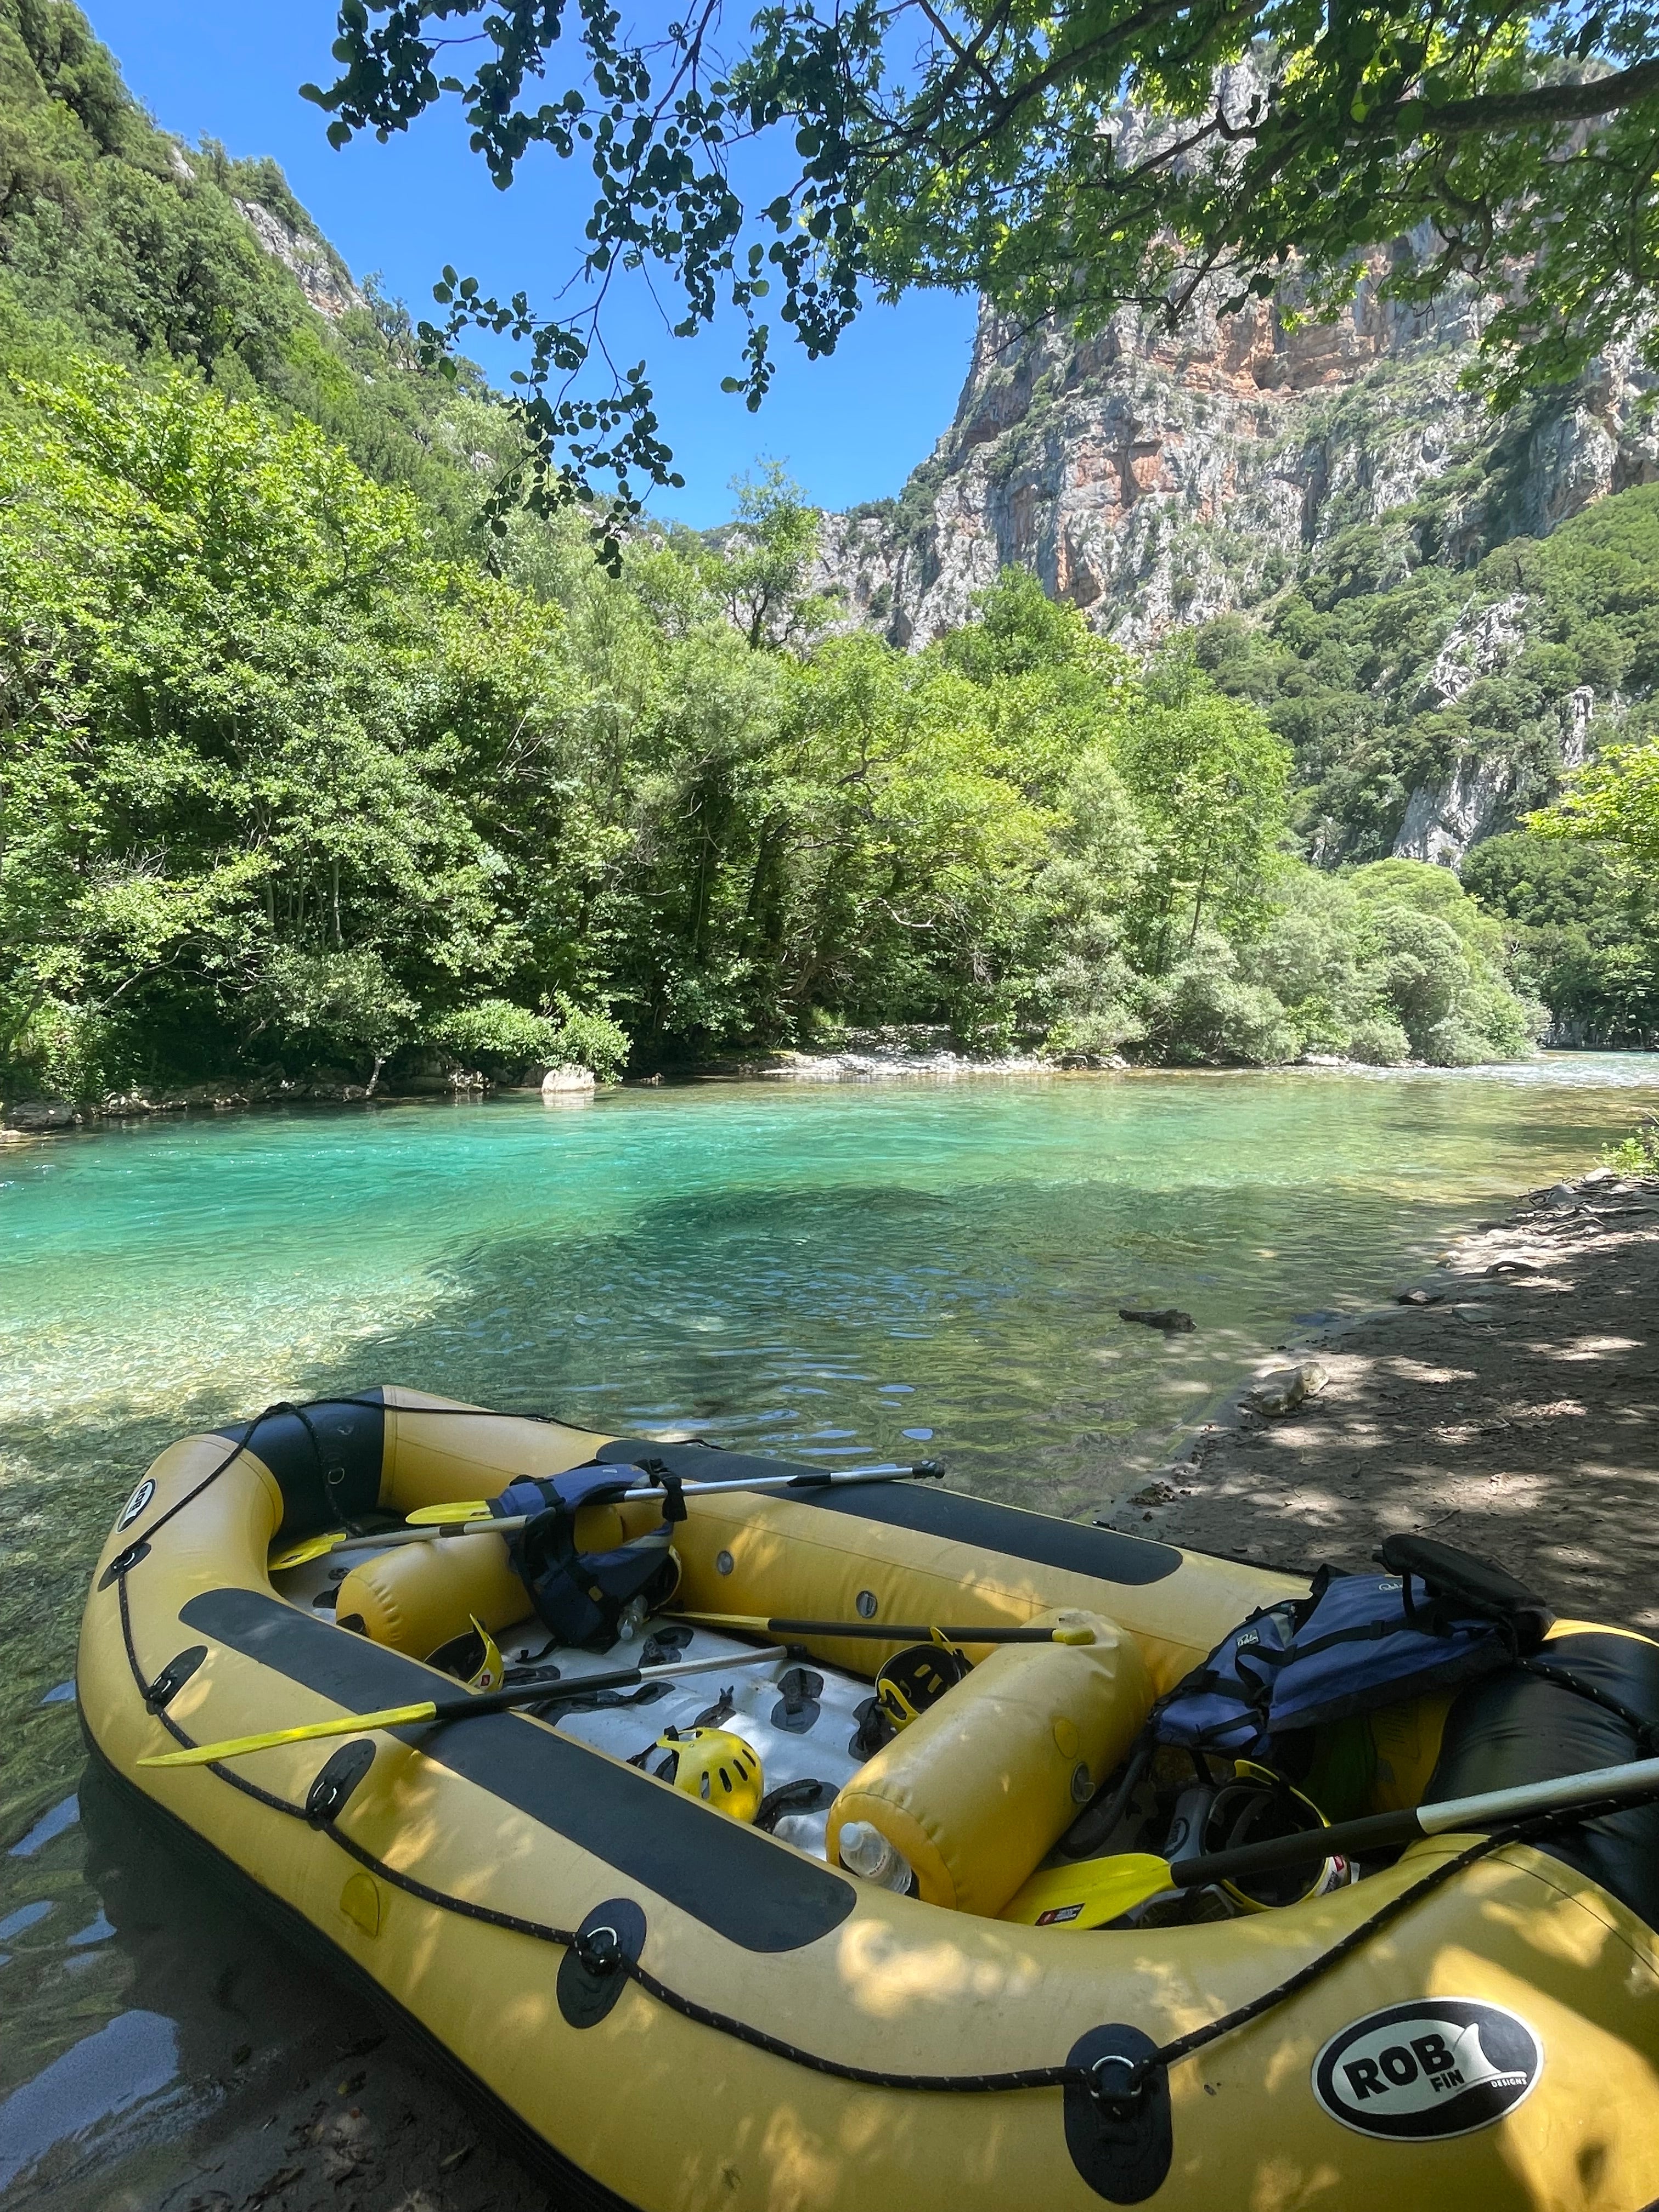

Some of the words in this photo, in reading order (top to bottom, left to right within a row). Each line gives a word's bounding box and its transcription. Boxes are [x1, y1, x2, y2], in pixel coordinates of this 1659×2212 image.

[1343, 2033, 1454, 2100] ROB
[1430, 2069, 1465, 2092] FIN
[1491, 2077, 1528, 2089] DESIGNS
